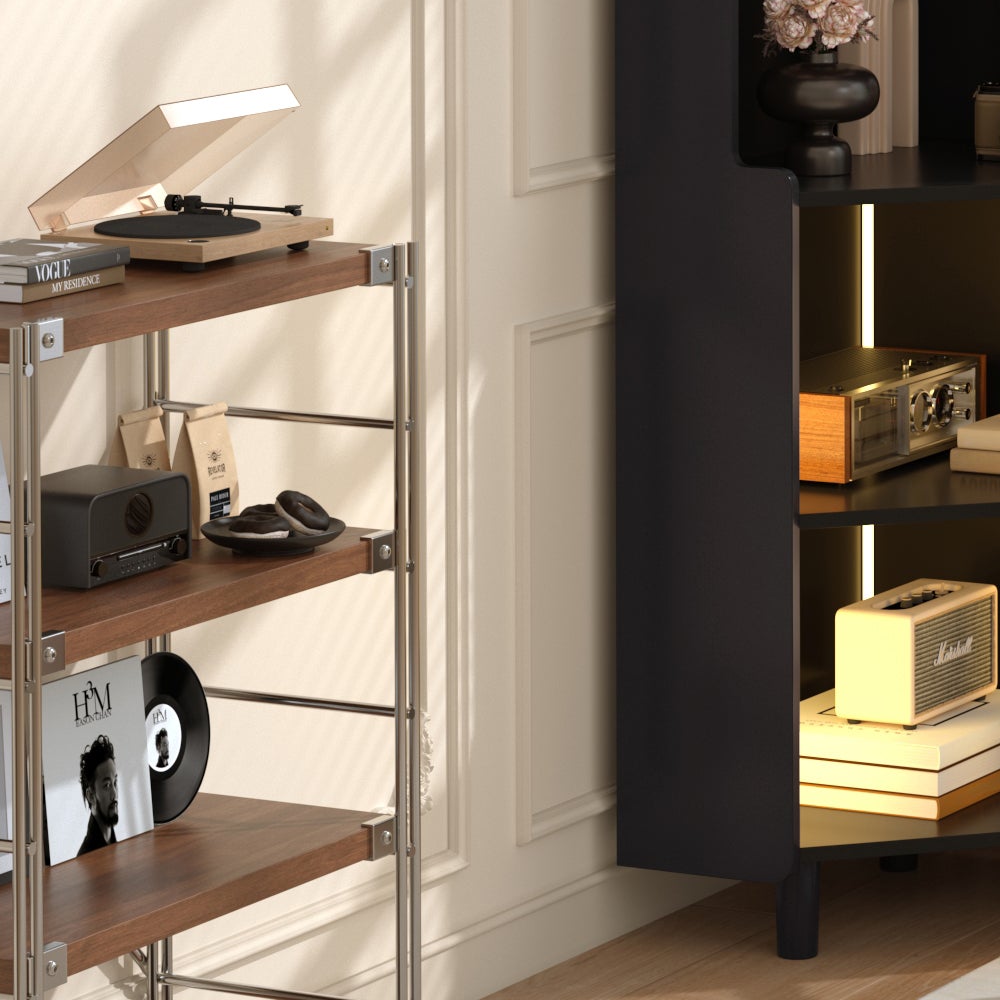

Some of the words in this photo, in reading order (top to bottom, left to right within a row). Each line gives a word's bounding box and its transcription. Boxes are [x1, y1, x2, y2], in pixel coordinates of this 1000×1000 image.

[35, 258, 71, 282] VOGUE
[51, 280, 63, 294] MY
[63, 273, 101, 291] RESIDENCE
